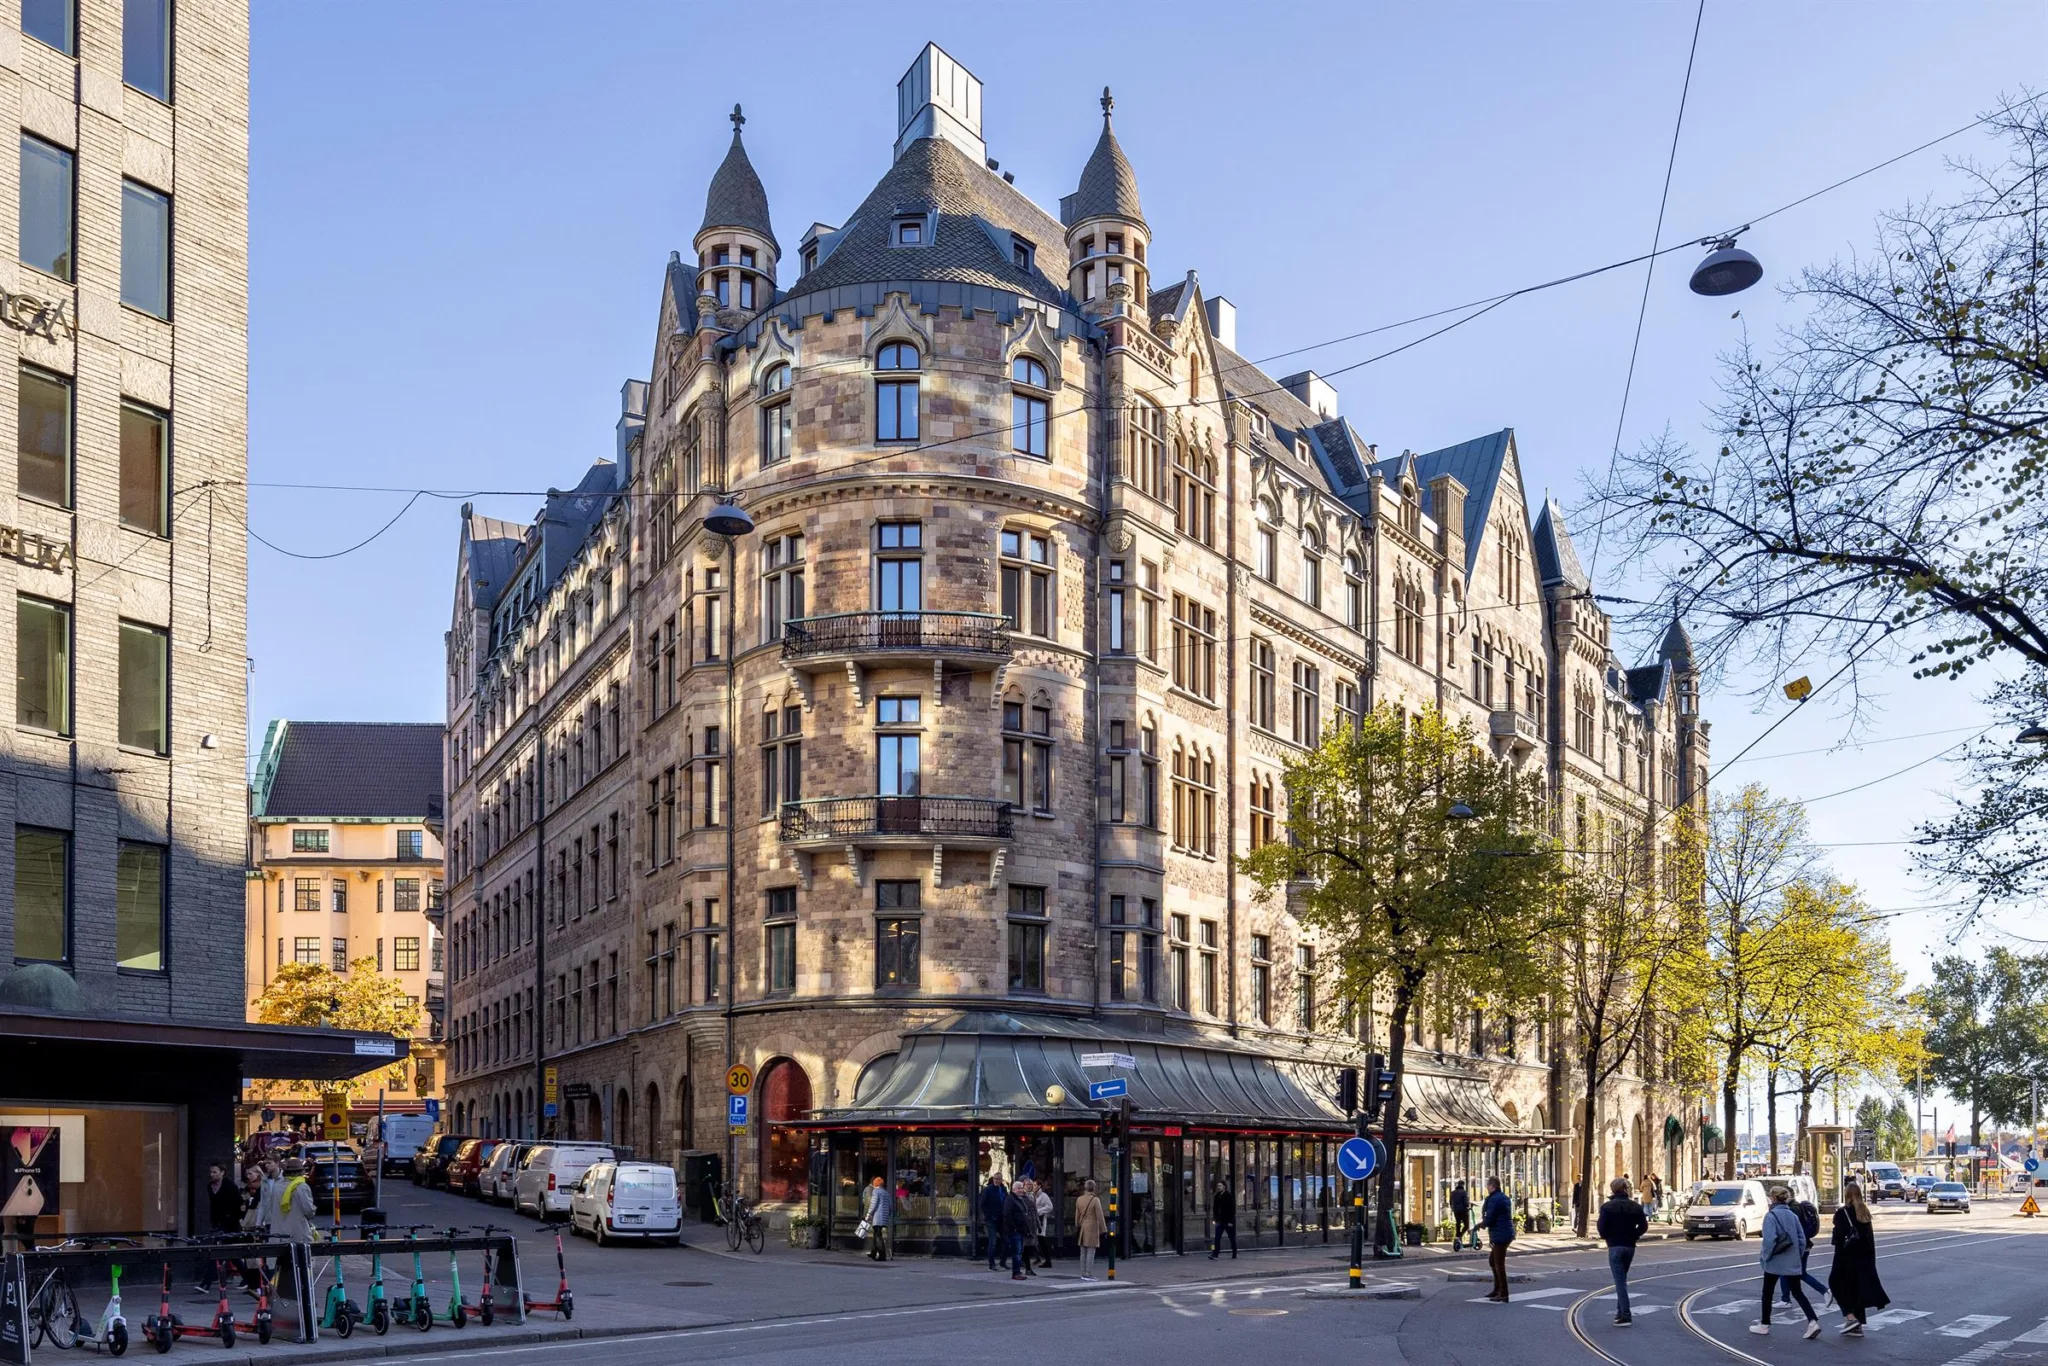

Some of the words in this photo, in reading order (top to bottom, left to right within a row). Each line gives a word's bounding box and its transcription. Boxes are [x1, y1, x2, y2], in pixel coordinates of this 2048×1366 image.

[731, 1072, 750, 1088] 30
[734, 1097, 745, 1113] P
[1822, 1165, 1834, 1189] BIG
[7, 1282, 13, 1297] P
